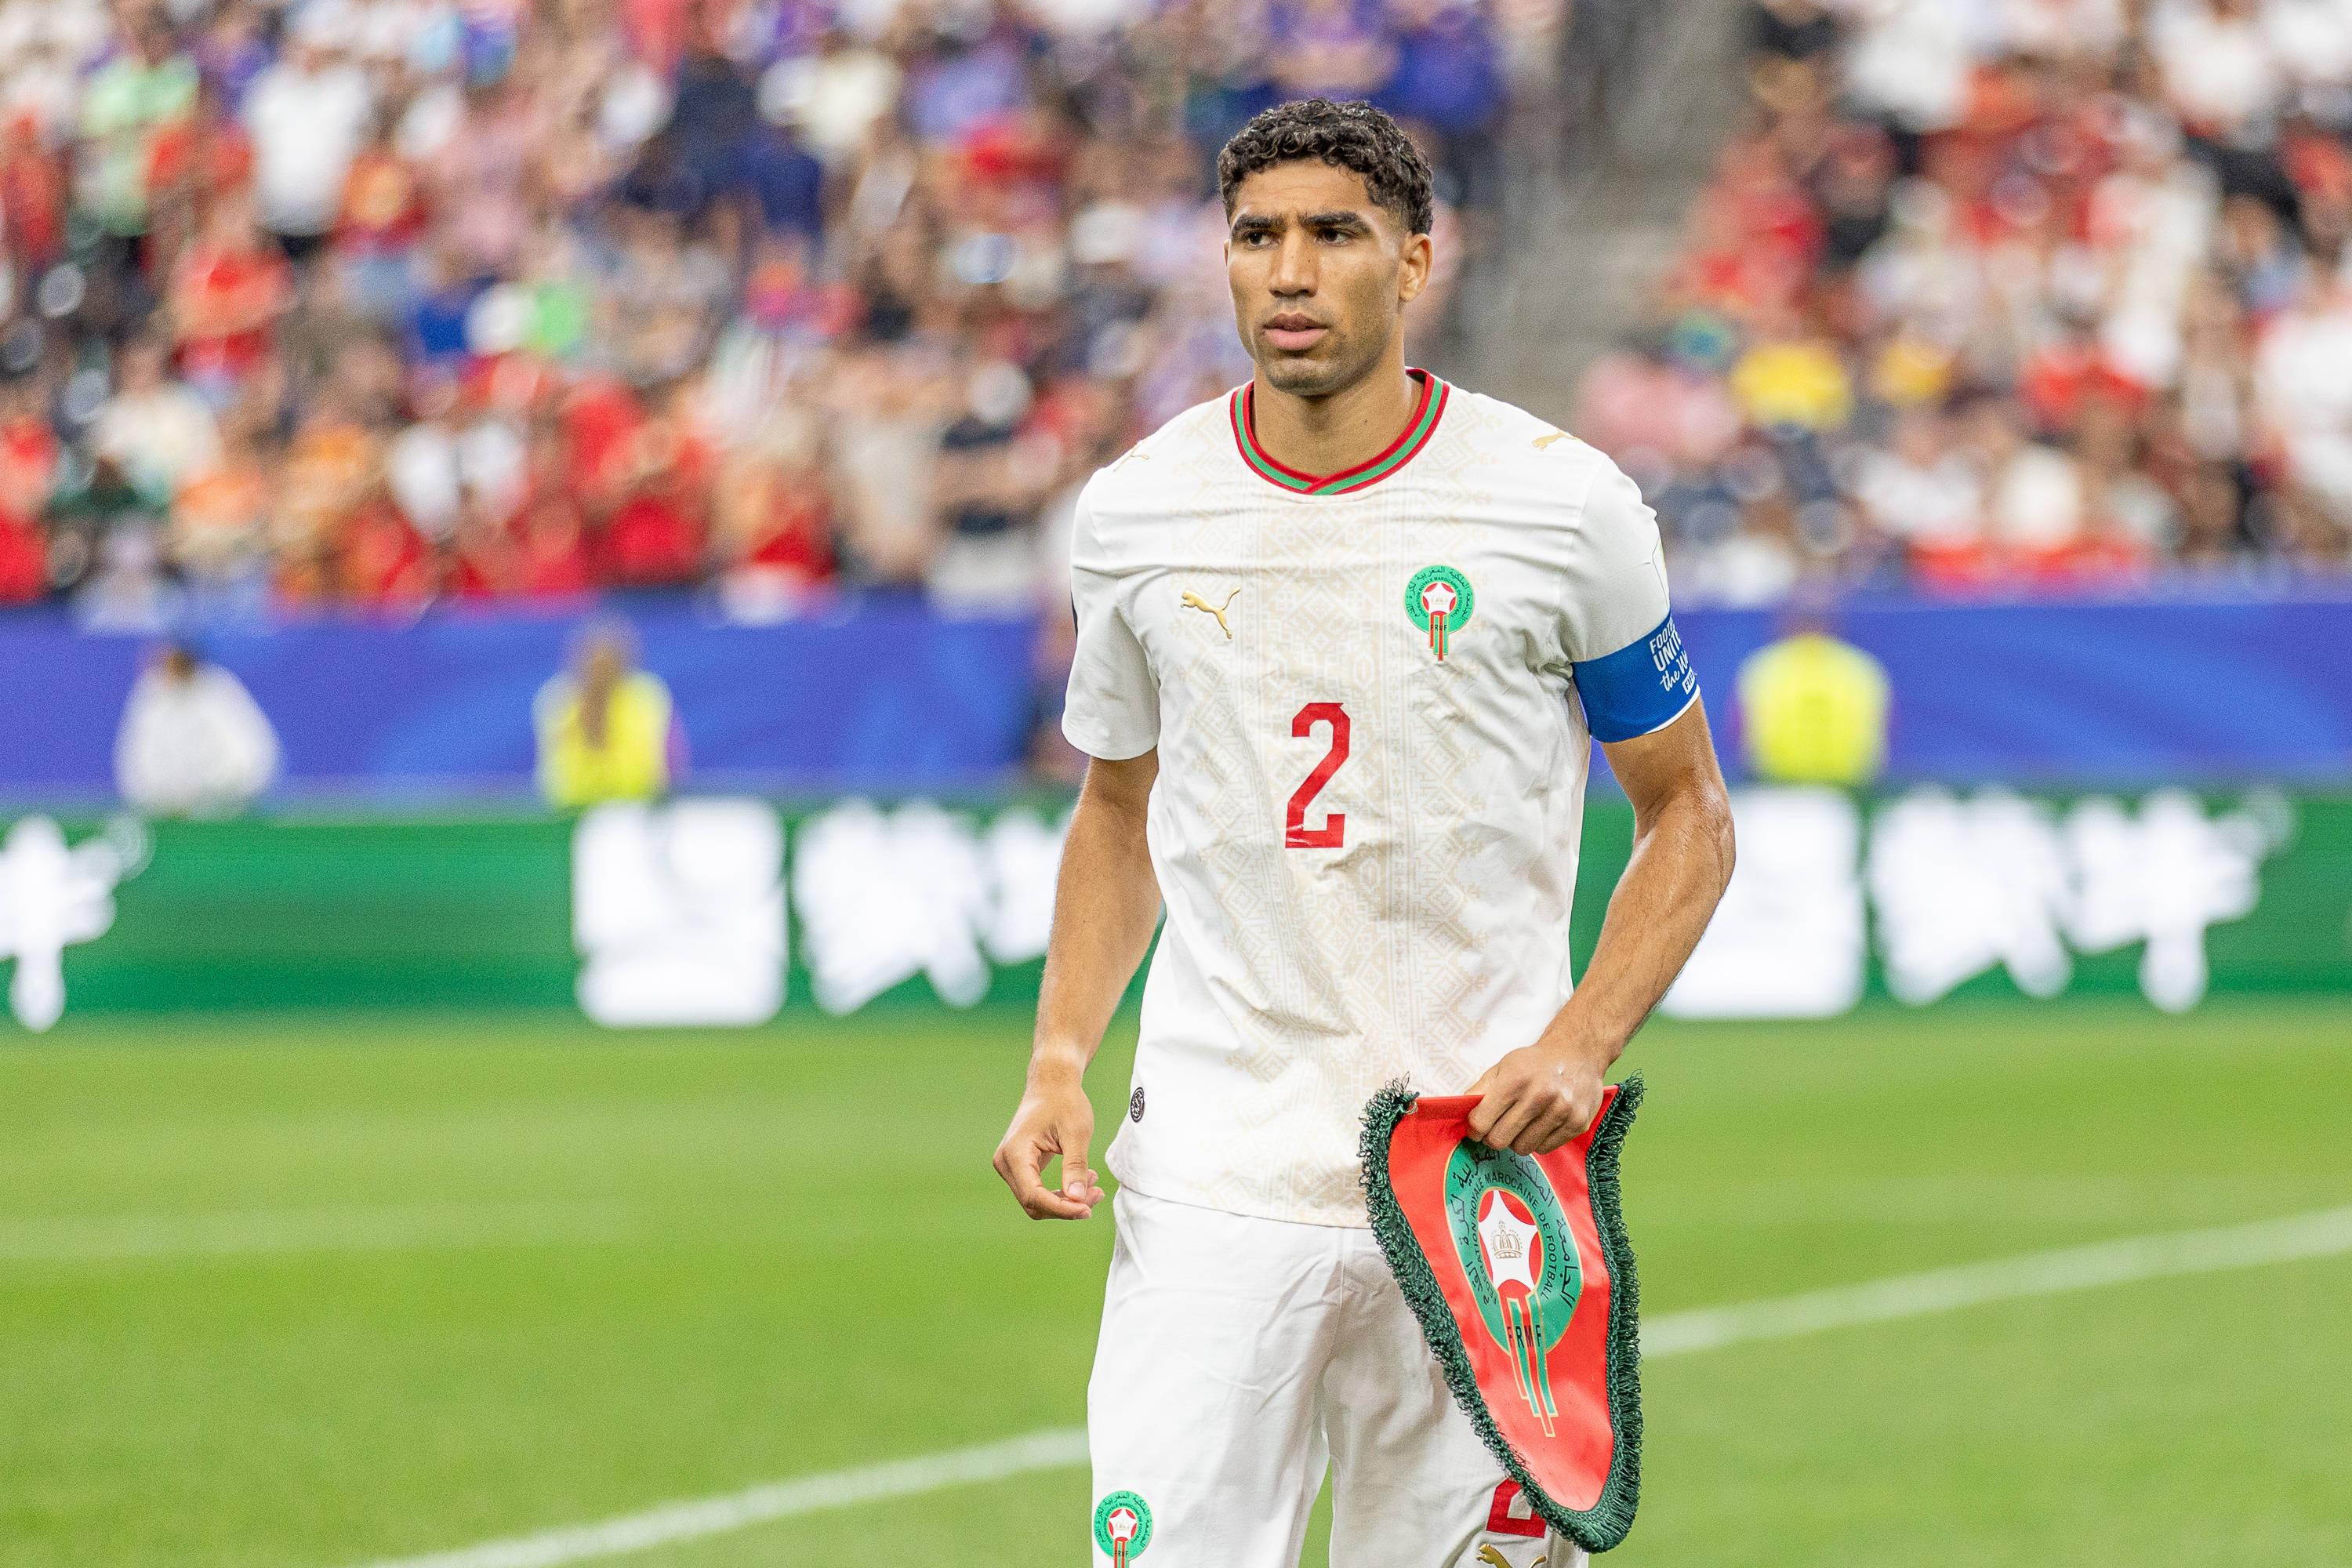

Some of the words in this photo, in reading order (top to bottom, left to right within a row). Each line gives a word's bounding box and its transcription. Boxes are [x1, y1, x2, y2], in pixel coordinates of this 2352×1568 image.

[1659, 670, 1680, 691] the
[1286, 702, 1350, 848] 2
[1470, 1177, 1484, 1218] ROYALE
[1484, 1172, 1539, 1210] MAROCAINE
[1450, 1193, 1470, 1246] لكرة
[1538, 1212, 1551, 1231] DE
[1465, 1261, 1490, 1305] القدم
[1541, 1235, 1557, 1300] FOOTBALL
[1556, 1217, 1579, 1308] الجامعة
[1507, 1325, 1541, 1348] FRMF
